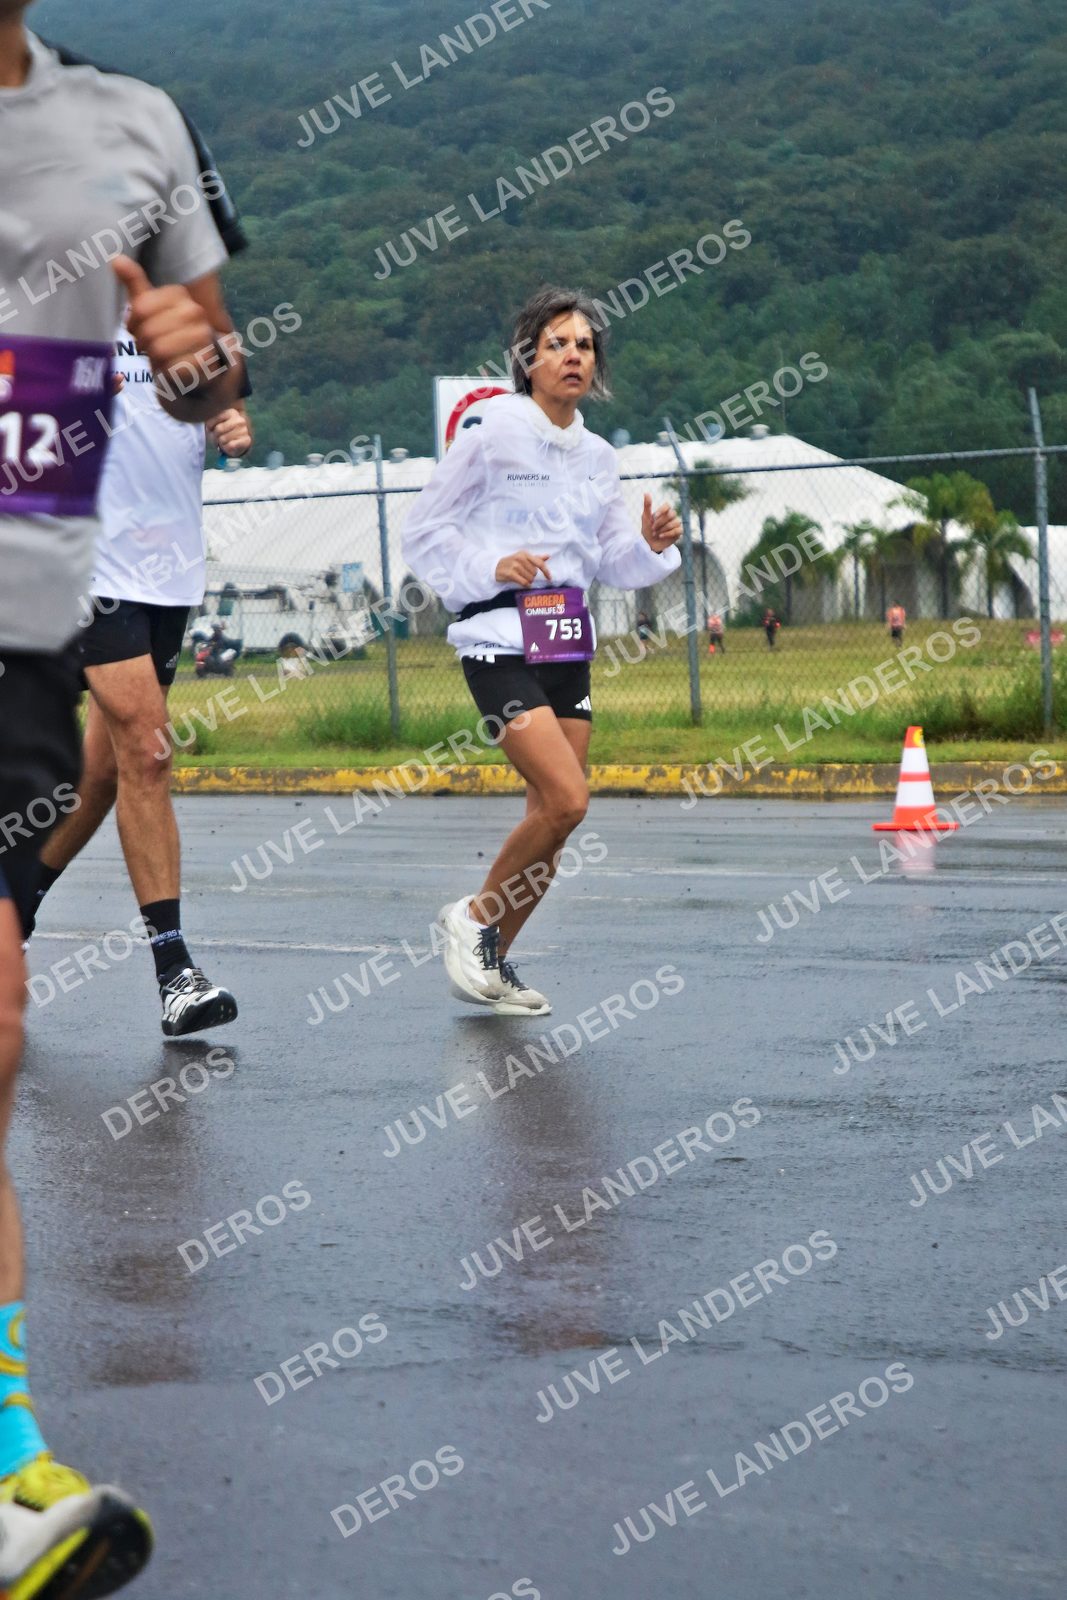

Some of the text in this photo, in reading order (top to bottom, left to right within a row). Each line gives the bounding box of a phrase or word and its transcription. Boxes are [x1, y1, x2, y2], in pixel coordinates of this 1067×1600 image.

[506, 473, 540, 481] RUNNERS
[524, 593, 565, 608] CARRERA
[525, 606, 556, 616] OMNILIFE
[545, 617, 582, 641] 753
